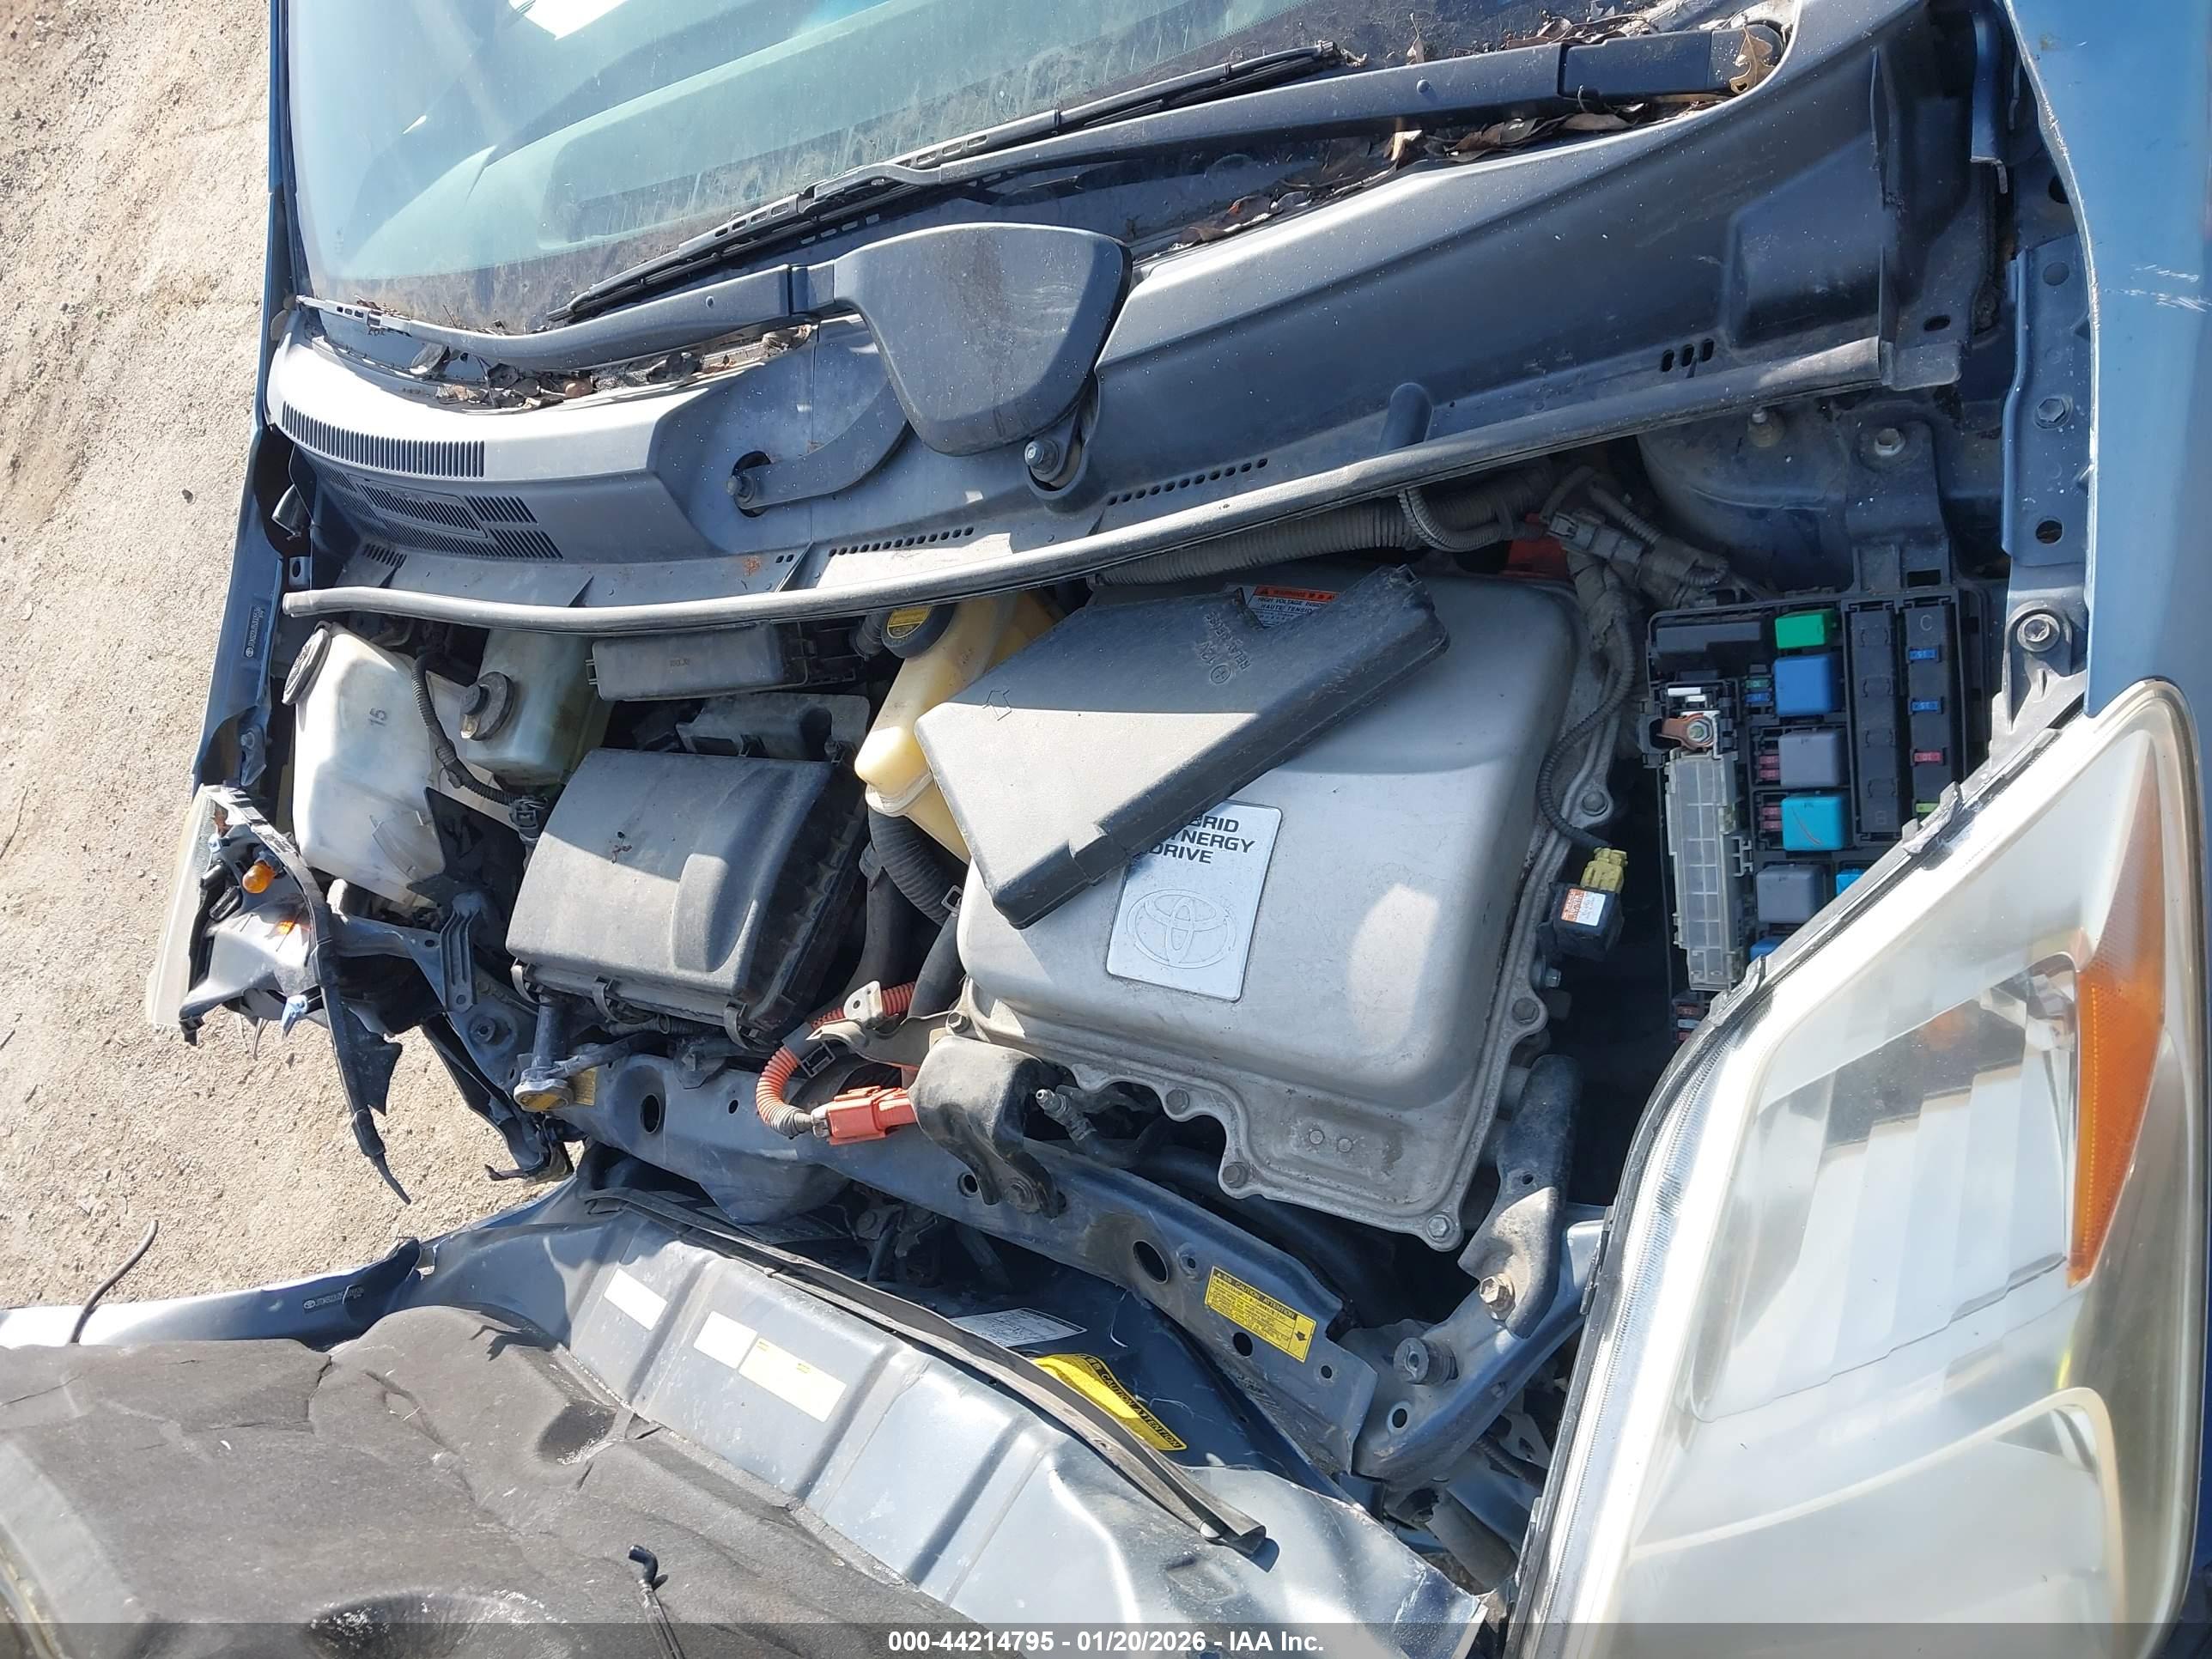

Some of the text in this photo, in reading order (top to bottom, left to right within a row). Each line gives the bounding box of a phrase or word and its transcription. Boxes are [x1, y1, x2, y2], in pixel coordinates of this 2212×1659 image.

[1288, 606, 1314, 616] TENSIO
[1920, 614, 1933, 631] C
[1149, 843, 1214, 865] DRIVE
[1236, 1281, 1295, 1319] CAUTION ATTENTION
[1101, 1373, 1182, 1448] CAUTION ATTENTION
